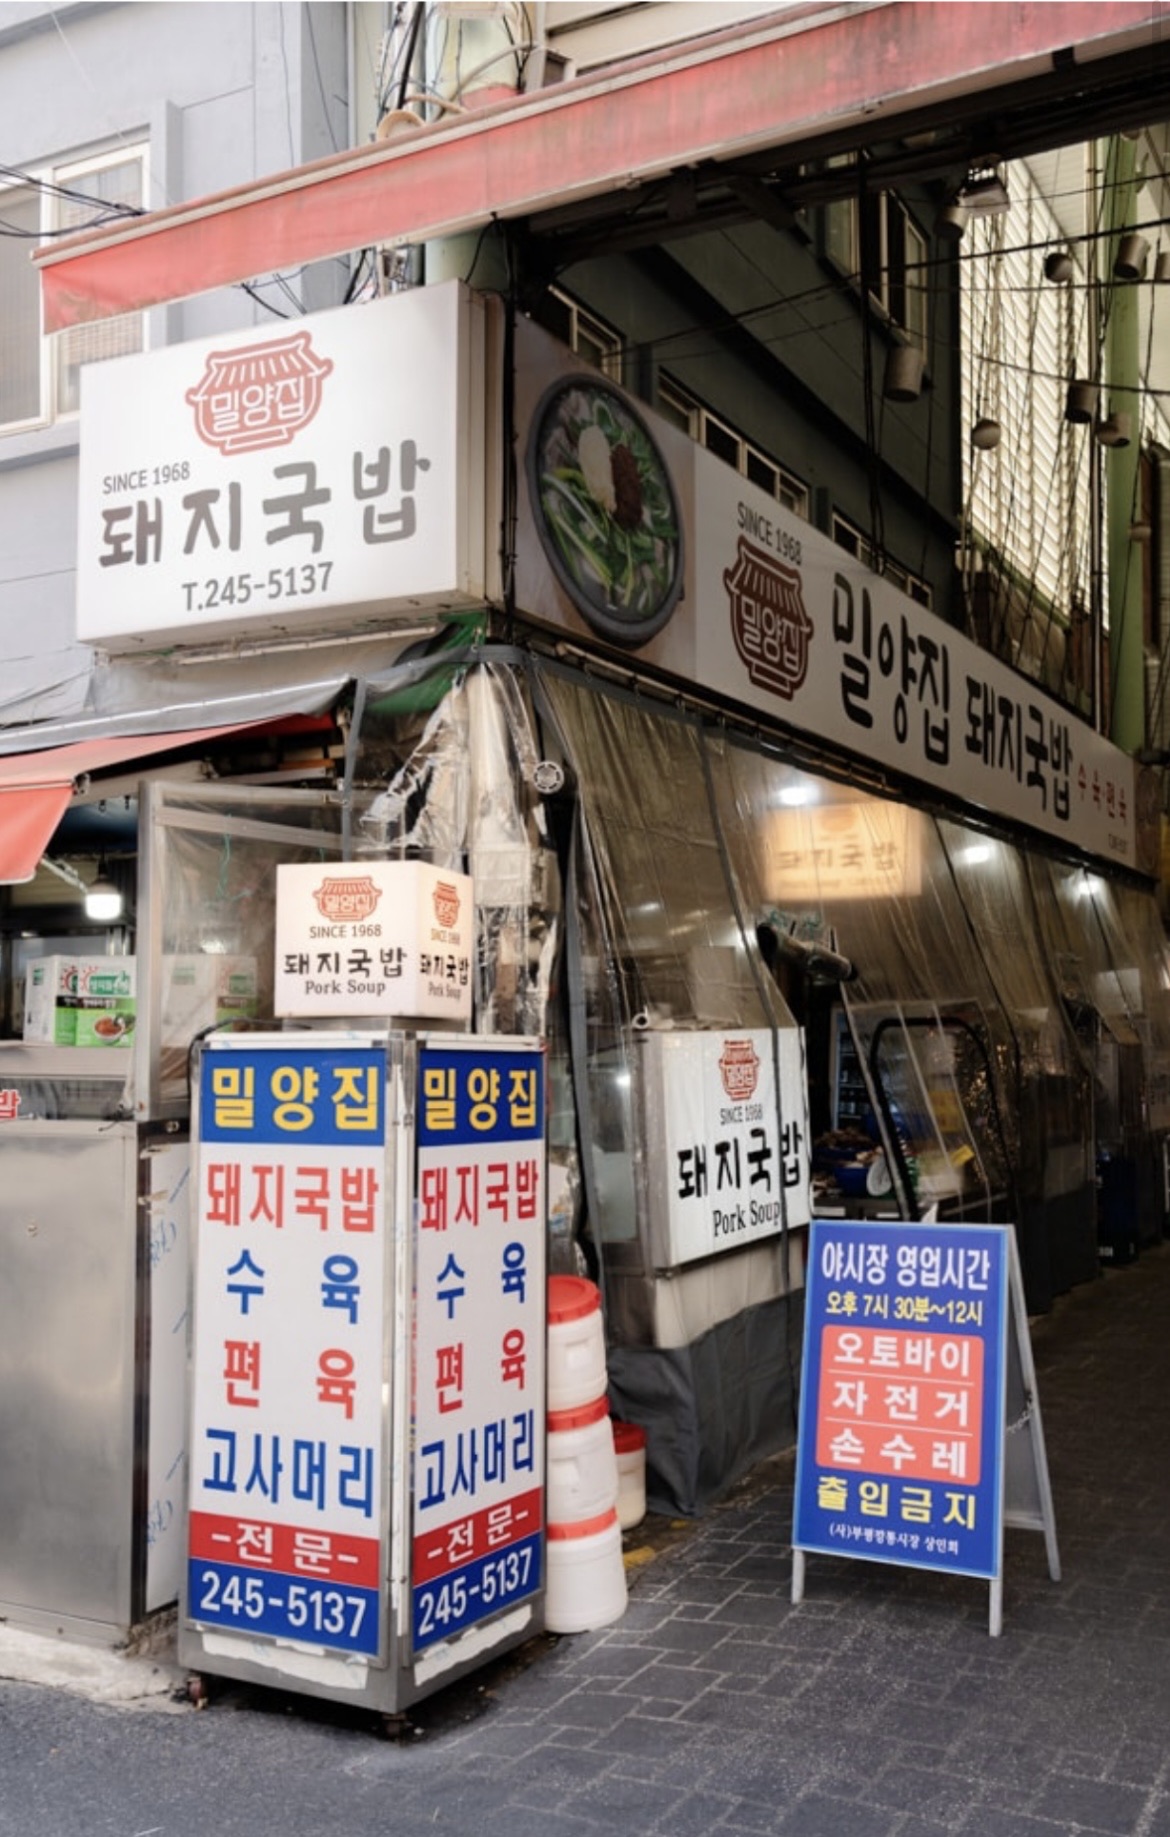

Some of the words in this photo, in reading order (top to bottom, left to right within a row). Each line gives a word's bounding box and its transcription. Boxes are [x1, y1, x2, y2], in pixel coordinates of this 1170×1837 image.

[210, 377, 305, 433] 밀양집
[99, 439, 431, 567] 돼지국밥
[103, 468, 147, 494] SINCE
[152, 461, 190, 484] 1968
[737, 501, 772, 548] SINCE
[775, 527, 802, 567] 1968
[182, 561, 334, 612] T.245-5137
[741, 594, 800, 673] 밀양집
[832, 571, 950, 766] 밀양집
[964, 674, 1074, 822] 돼지국밥
[284, 947, 407, 978] 돼지국밥
[309, 926, 347, 939] SINCE
[352, 924, 382, 938] 1968
[305, 980, 341, 994] Pork
[347, 980, 386, 997] Soup
[212, 1066, 379, 1131] 밀양집
[424, 1068, 536, 1130] 밀양집
[720, 1105, 743, 1125] SINCE
[677, 1121, 803, 1199] 돼지국밥
[206, 1163, 379, 1233] 돼지국밥
[421, 1159, 538, 1232] 돼지국밥
[713, 1204, 746, 1237] Pork
[750, 1199, 781, 1226] Soup
[821, 1241, 889, 1285] 야시장
[896, 1246, 990, 1290] 영업시간
[826, 1291, 858, 1316] 오후
[863, 1293, 889, 1319] 7시
[834, 1333, 970, 1377] 오토바이
[203, 1428, 374, 1519] 고사머리
[419, 1408, 534, 1511] 고사머리
[817, 1476, 976, 1530] 출입금지
[200, 1570, 366, 1638] 245-5137
[418, 1546, 533, 1637] 245-5137
